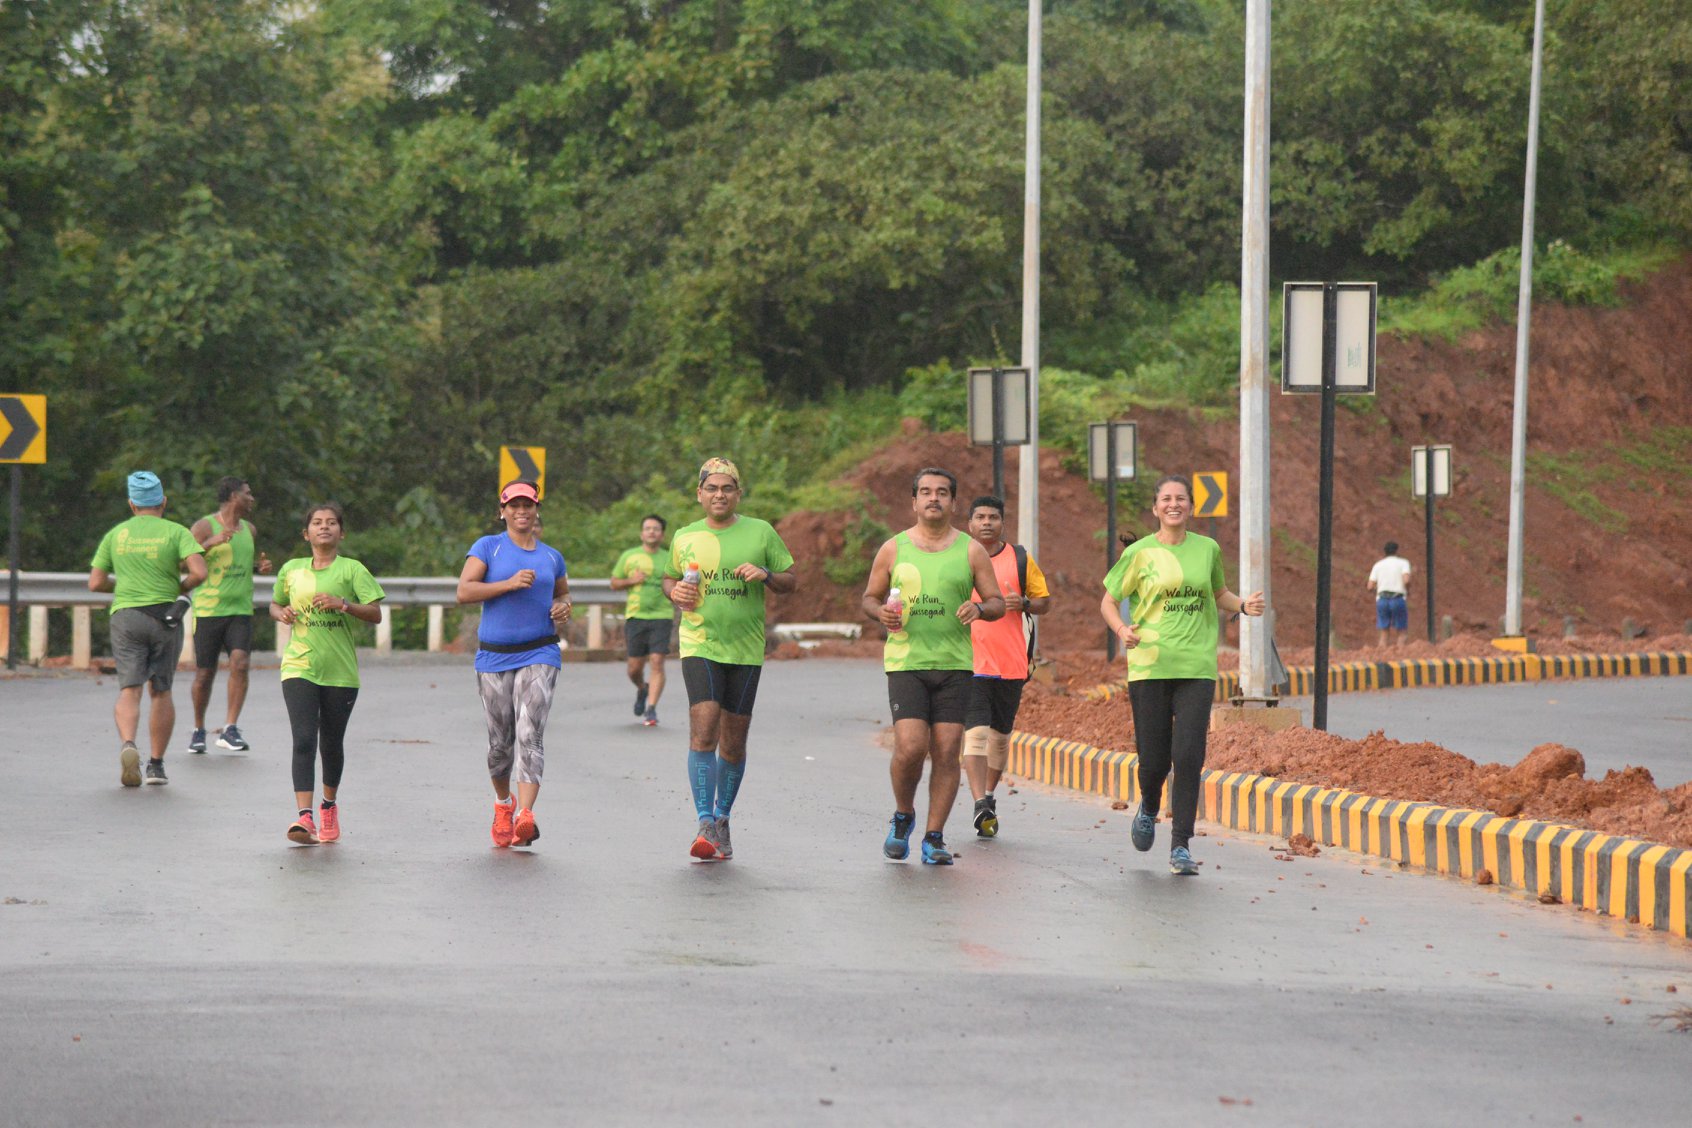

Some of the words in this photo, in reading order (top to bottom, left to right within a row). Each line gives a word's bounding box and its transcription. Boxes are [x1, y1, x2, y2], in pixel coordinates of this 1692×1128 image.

[702, 569, 718, 581] We
[1165, 587, 1181, 598] We
[908, 595, 920, 604] We
